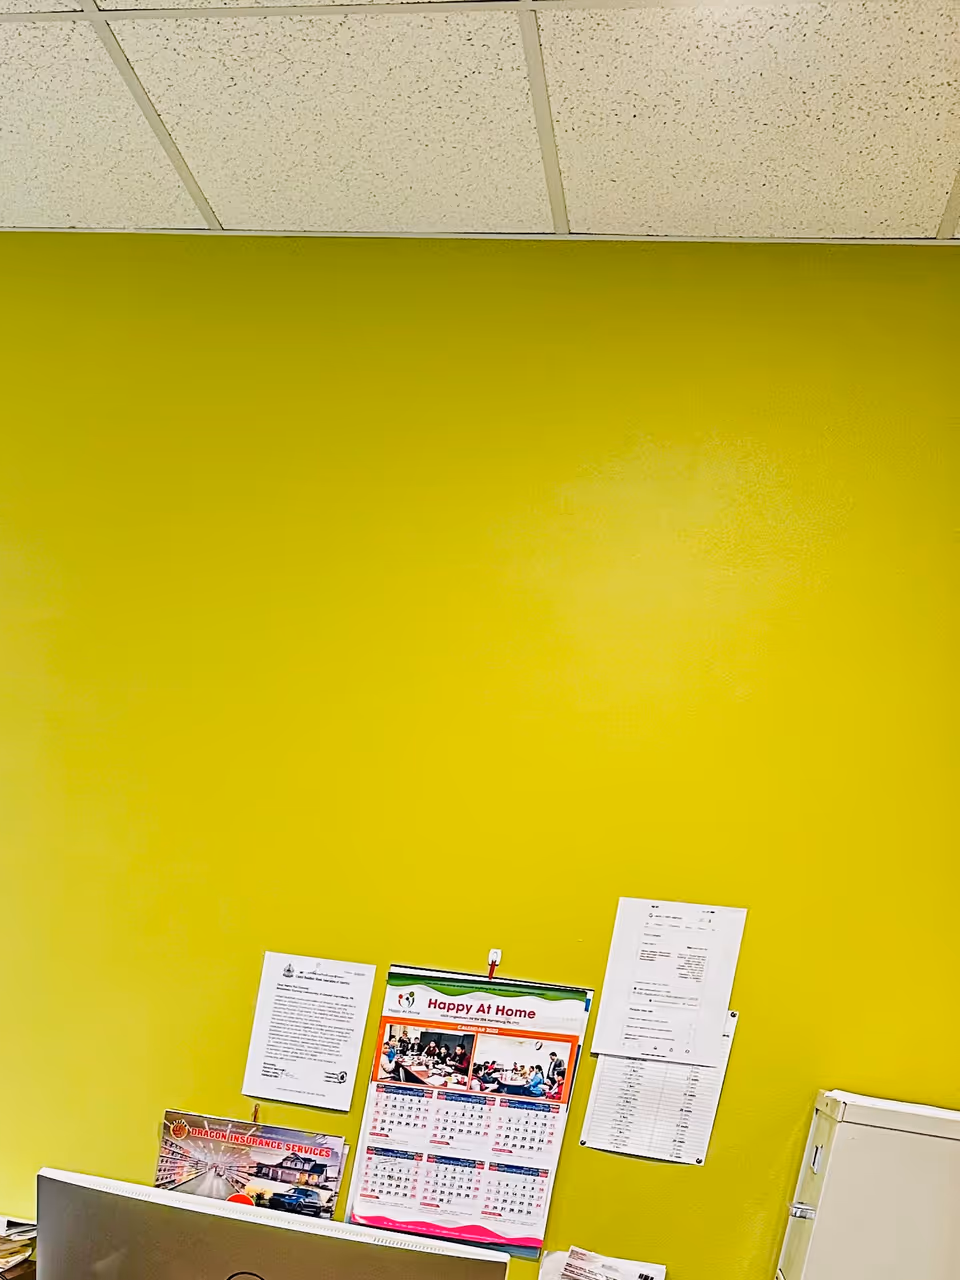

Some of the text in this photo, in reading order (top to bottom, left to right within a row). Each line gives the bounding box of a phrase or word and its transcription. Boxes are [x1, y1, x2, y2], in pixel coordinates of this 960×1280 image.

[427, 998, 536, 1019] Happy At Home
[457, 1024, 485, 1032] CALENDAR
[191, 1127, 227, 1141] DRAGON
[229, 1134, 283, 1150] INSURANCE
[285, 1143, 332, 1158] SERVICES
